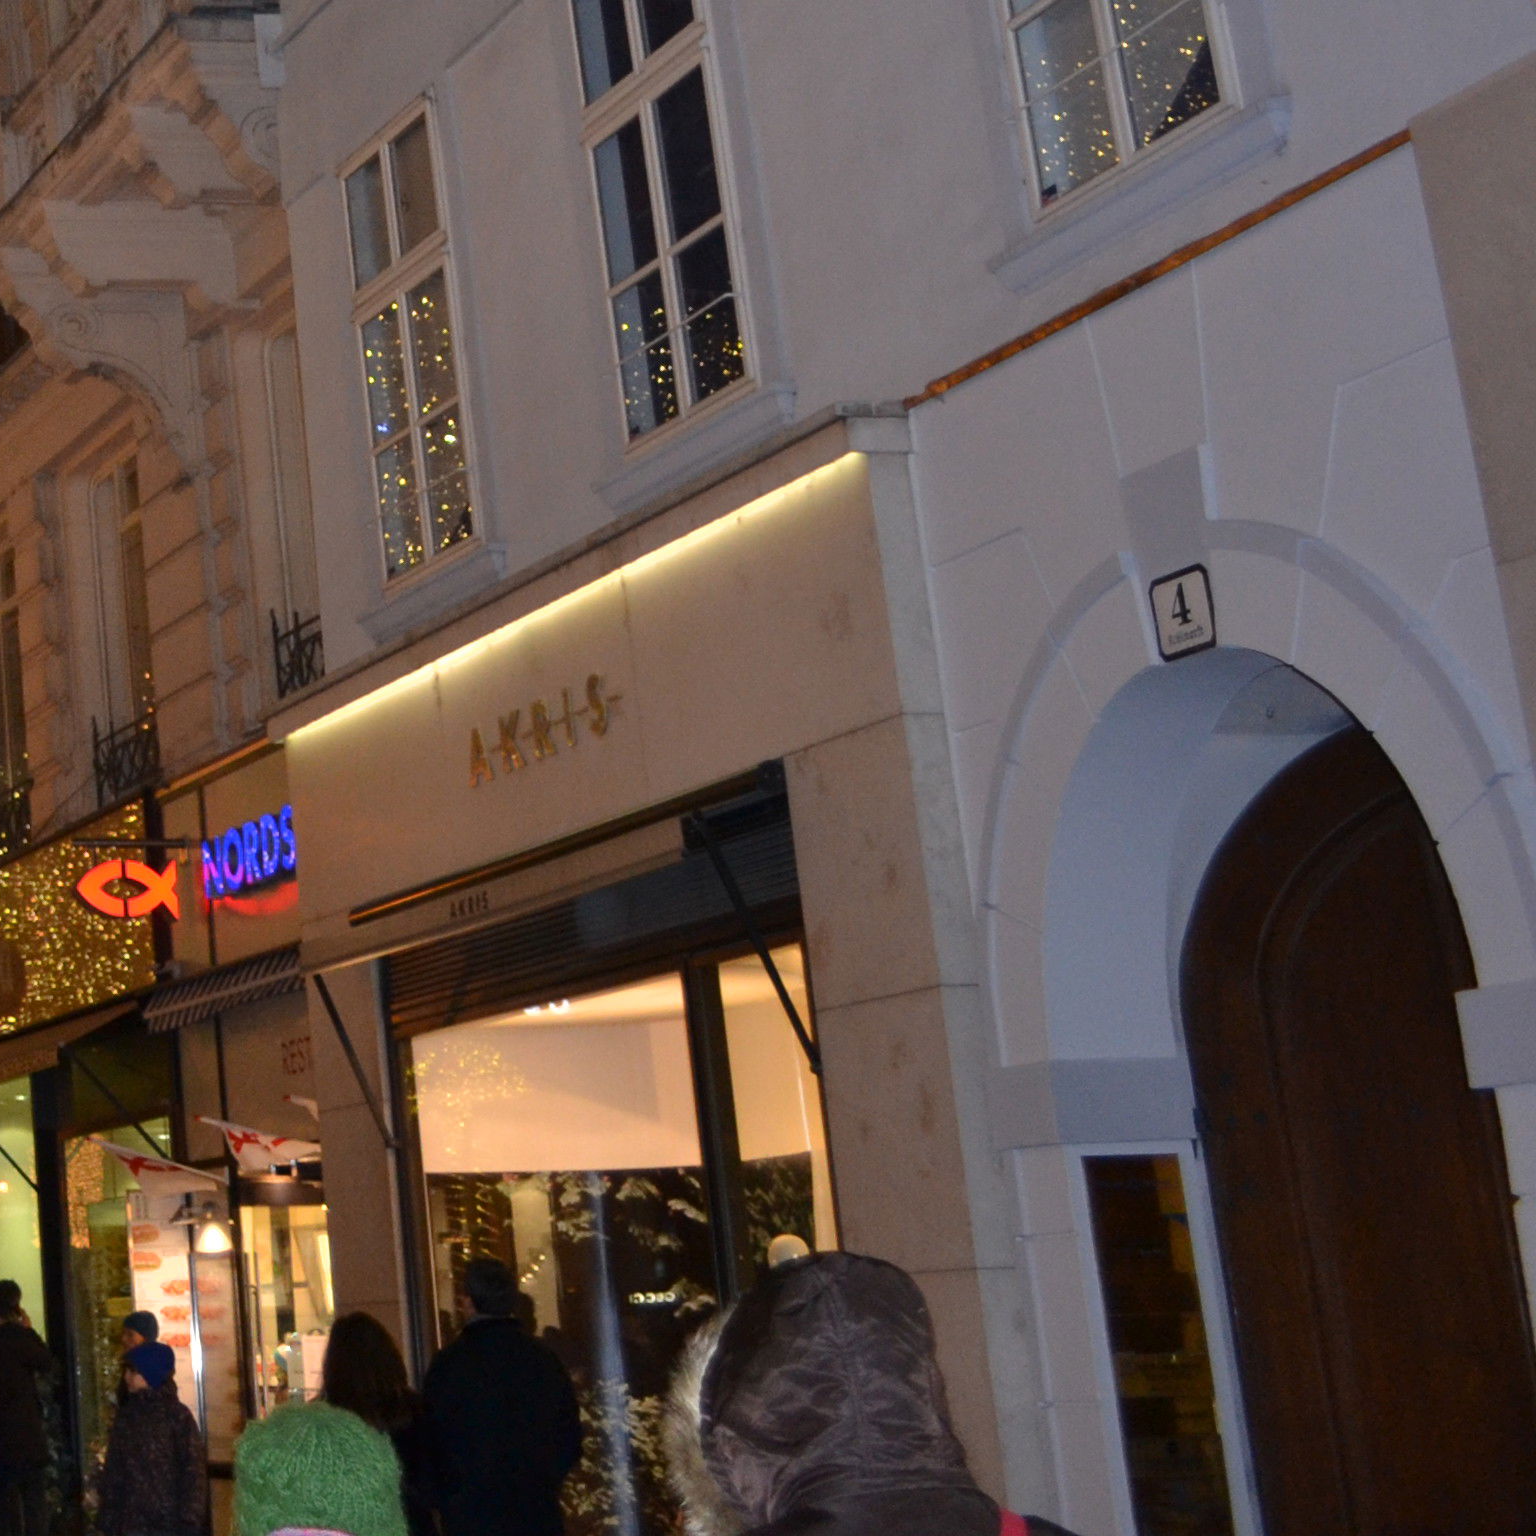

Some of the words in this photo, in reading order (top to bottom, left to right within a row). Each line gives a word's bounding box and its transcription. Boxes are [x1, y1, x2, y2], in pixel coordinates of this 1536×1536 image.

[1171, 582, 1193, 626] 4
[201, 802, 297, 900] NORDS
[449, 890, 490, 921] AKRIS
